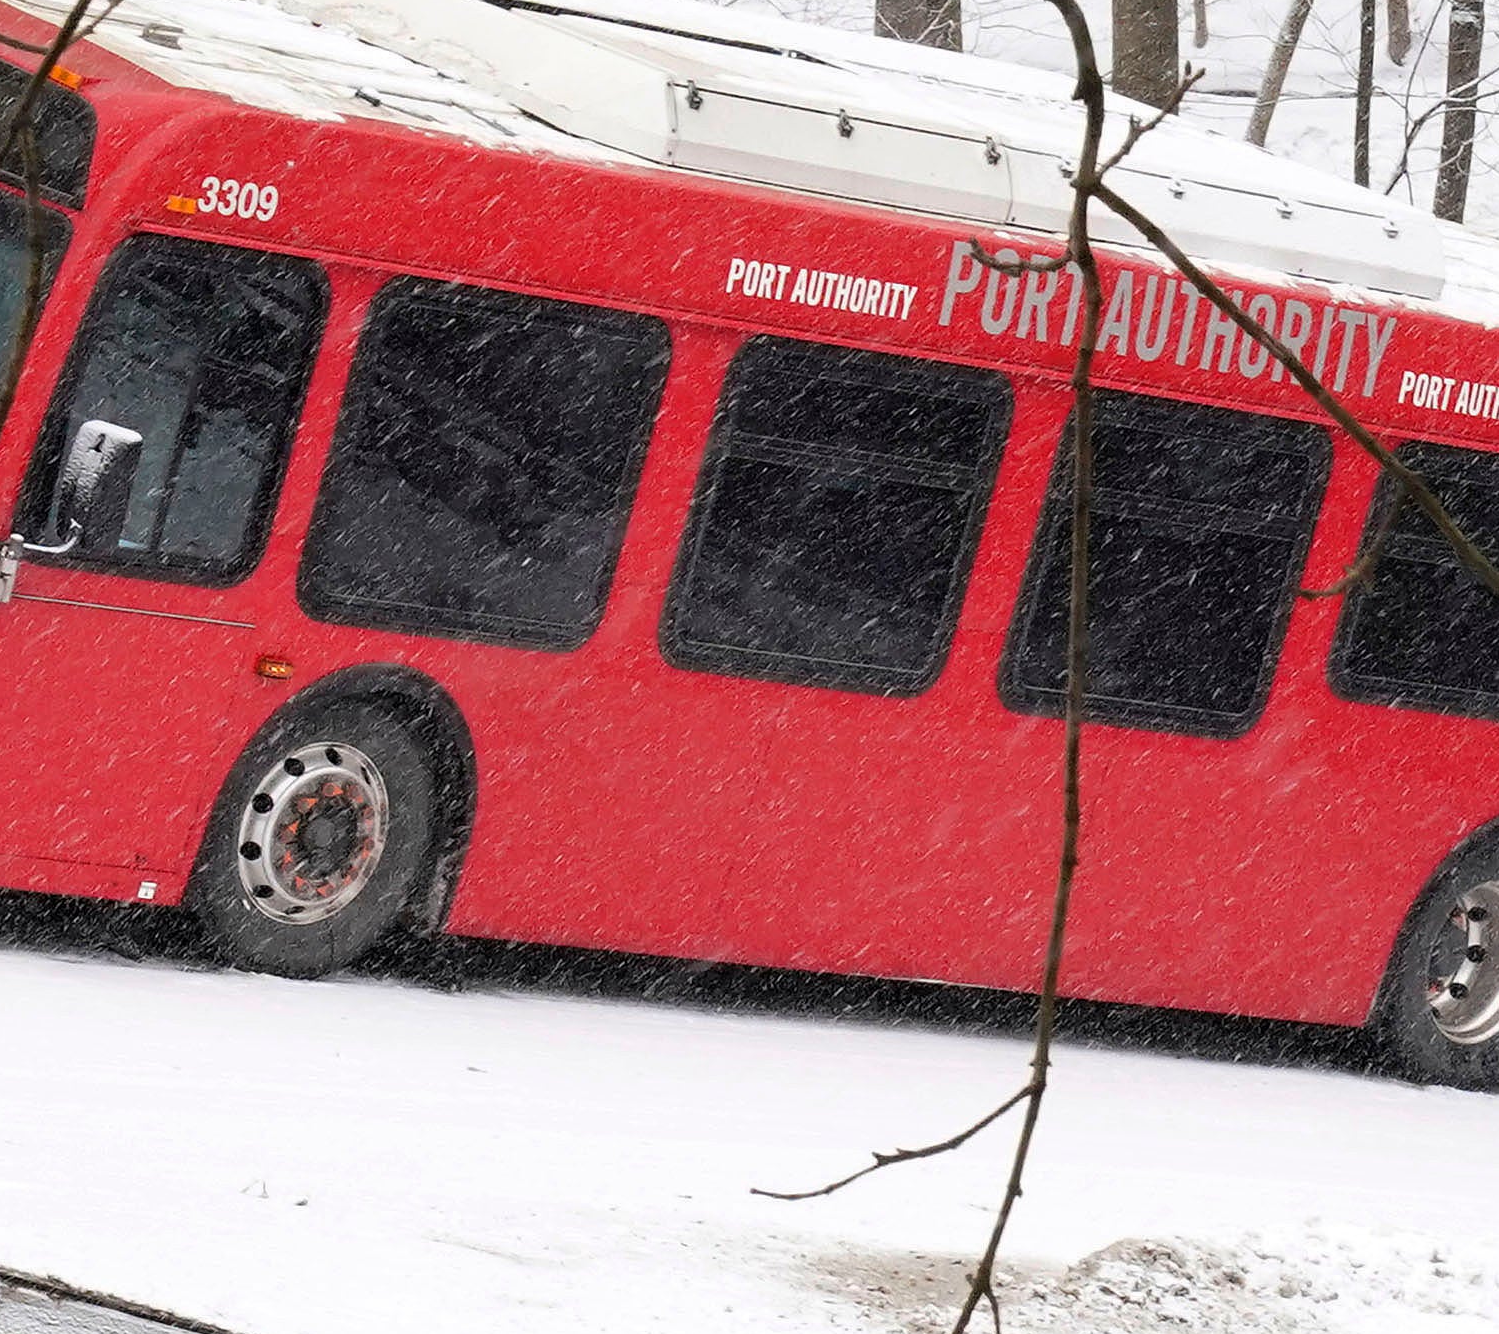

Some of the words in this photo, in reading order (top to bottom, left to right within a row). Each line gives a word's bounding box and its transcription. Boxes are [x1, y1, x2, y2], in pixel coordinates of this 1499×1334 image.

[198, 176, 278, 221] 3309
[726, 258, 791, 300] PORT
[790, 269, 918, 320] AUTHORITY
[938, 240, 1085, 347] PORT
[1094, 270, 1397, 398] AUTHORITY
[1398, 371, 1455, 411] PORT
